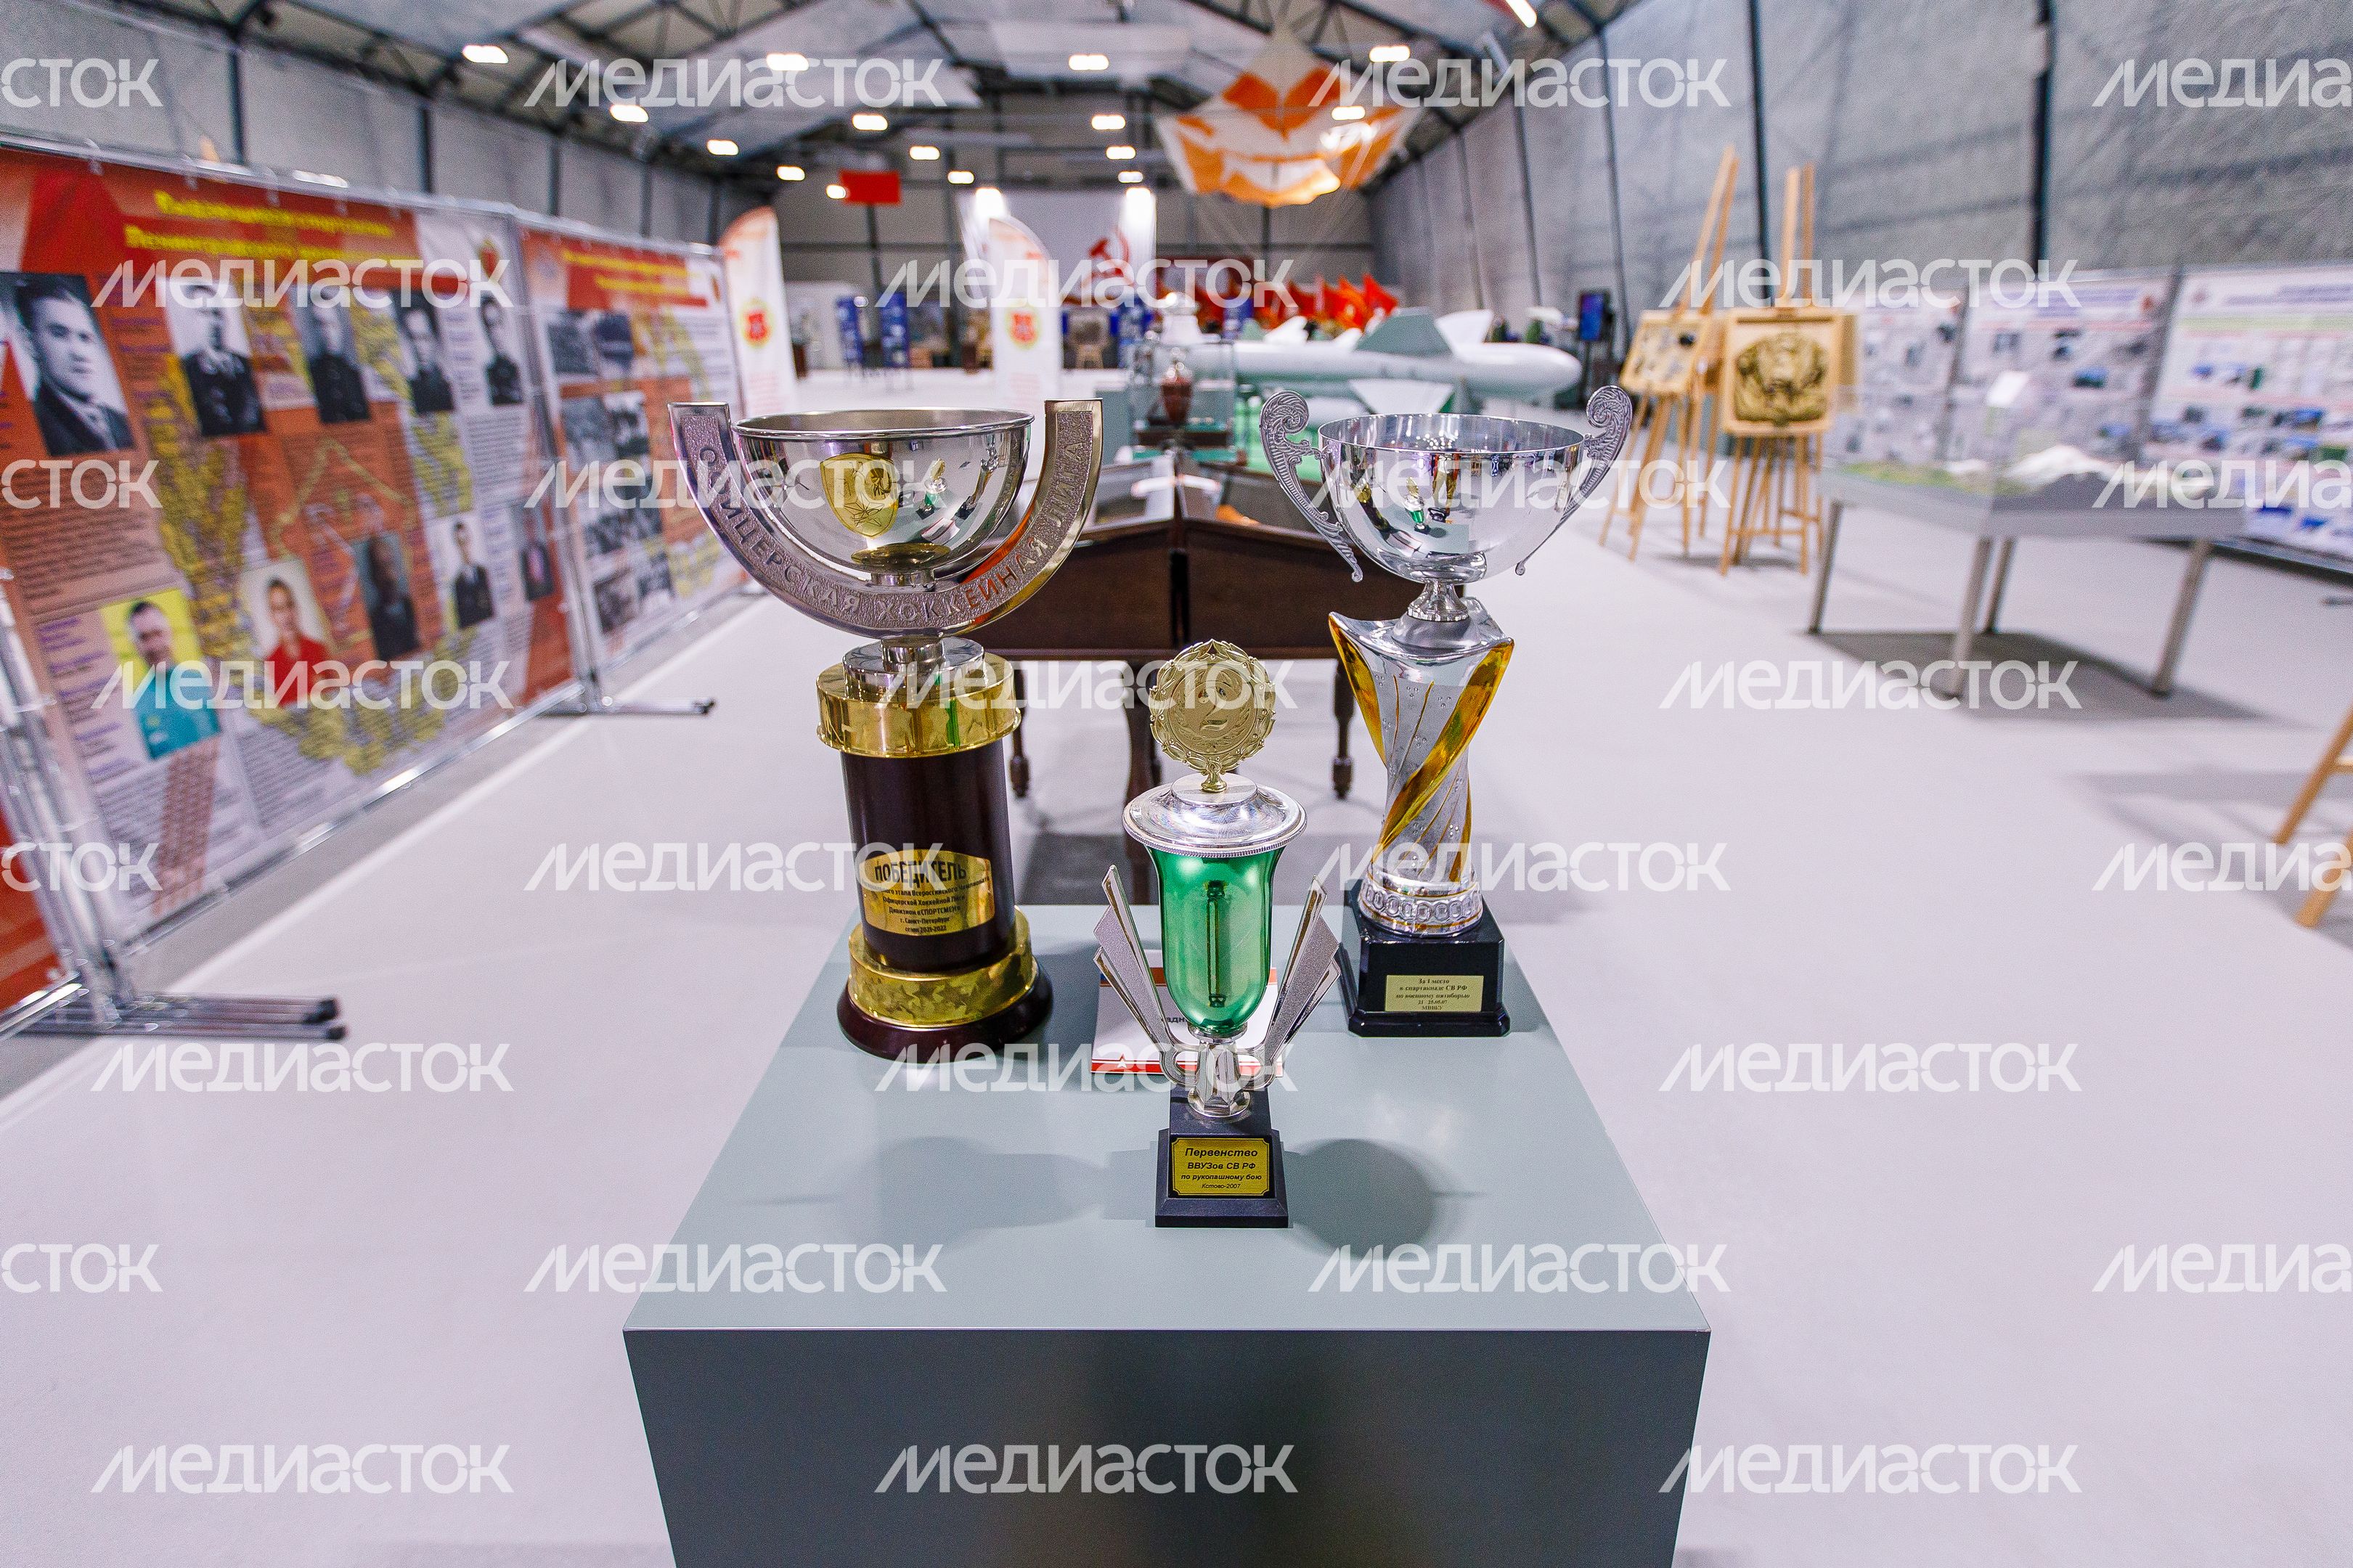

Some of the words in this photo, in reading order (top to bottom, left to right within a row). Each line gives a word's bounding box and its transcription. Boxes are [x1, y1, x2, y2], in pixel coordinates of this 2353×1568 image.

[1048, 442, 1084, 528] ЛИГА
[875, 860, 968, 889] ПОБЕДИТЕЛЬ
[1185, 1148, 1258, 1159] Первенство
